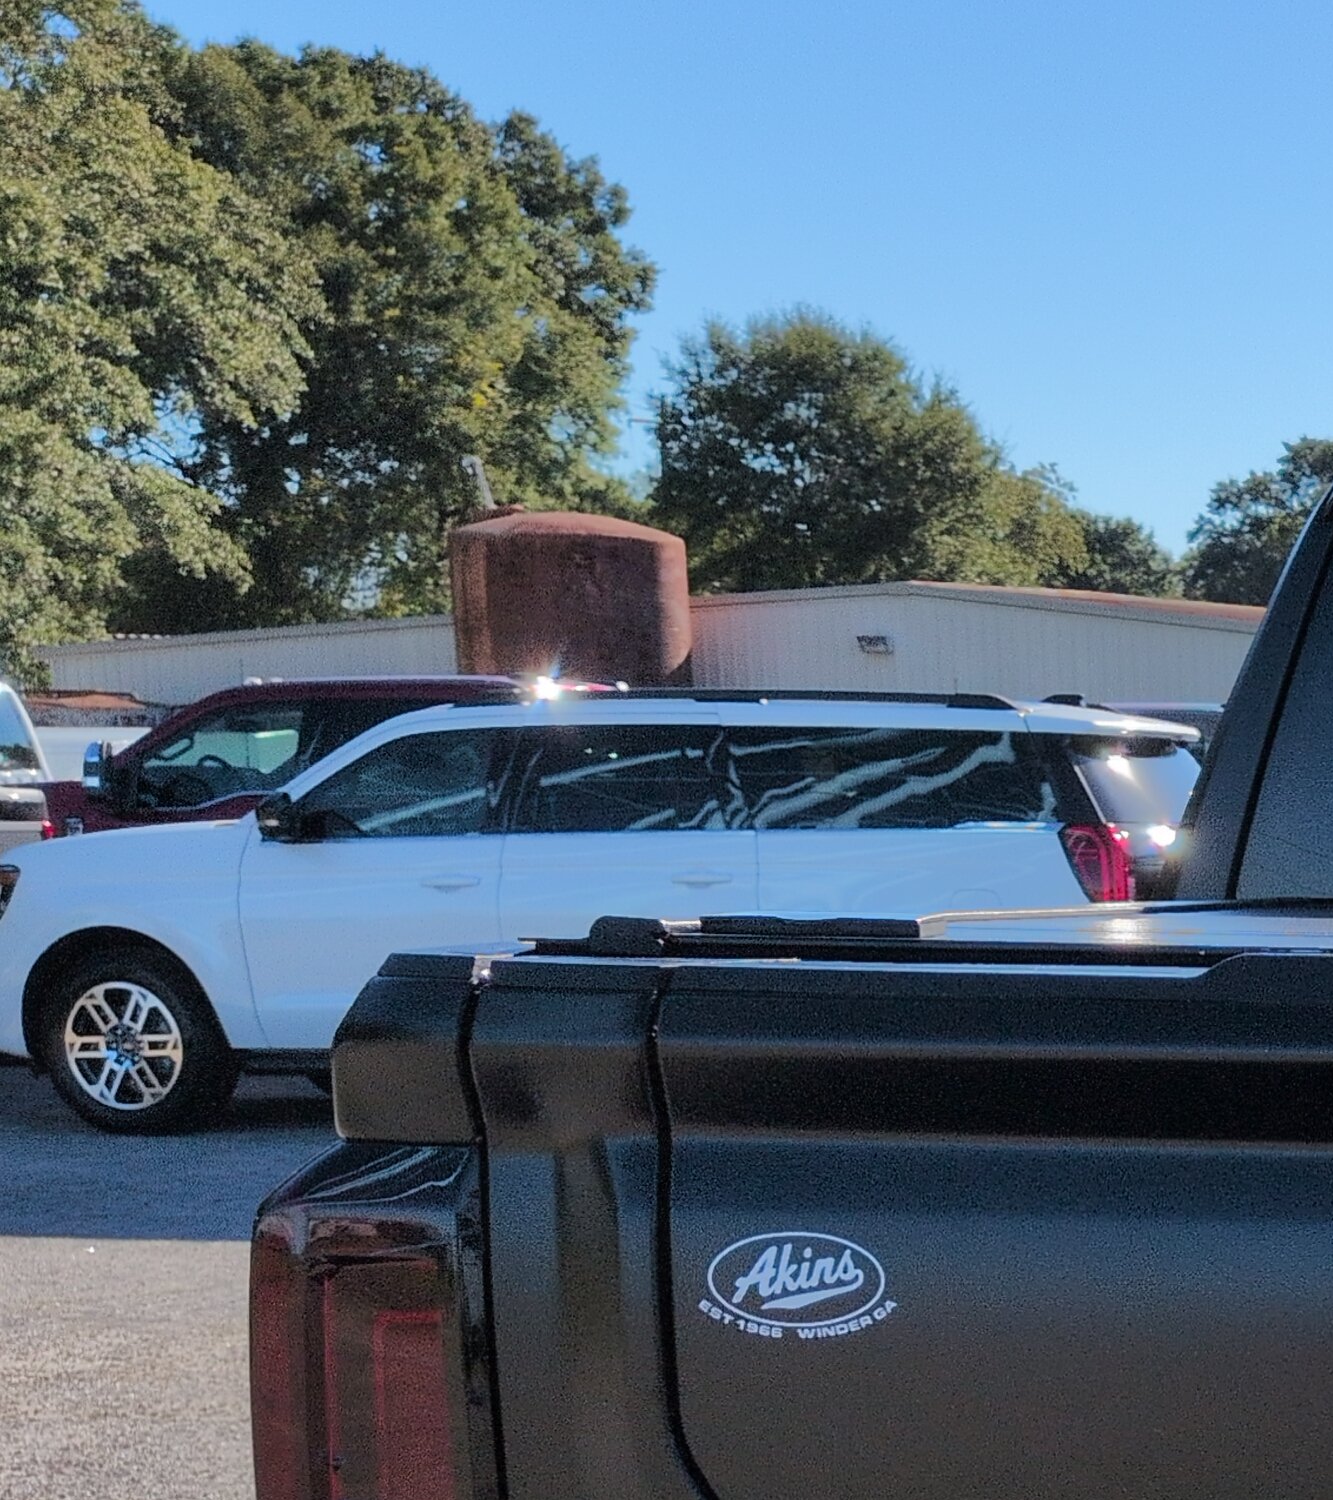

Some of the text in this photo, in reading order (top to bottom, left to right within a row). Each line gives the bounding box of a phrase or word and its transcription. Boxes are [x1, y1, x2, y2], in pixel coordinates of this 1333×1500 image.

[732, 1243, 864, 1309] Akins
[698, 1299, 898, 1339] EST 1966 WINDER GA
